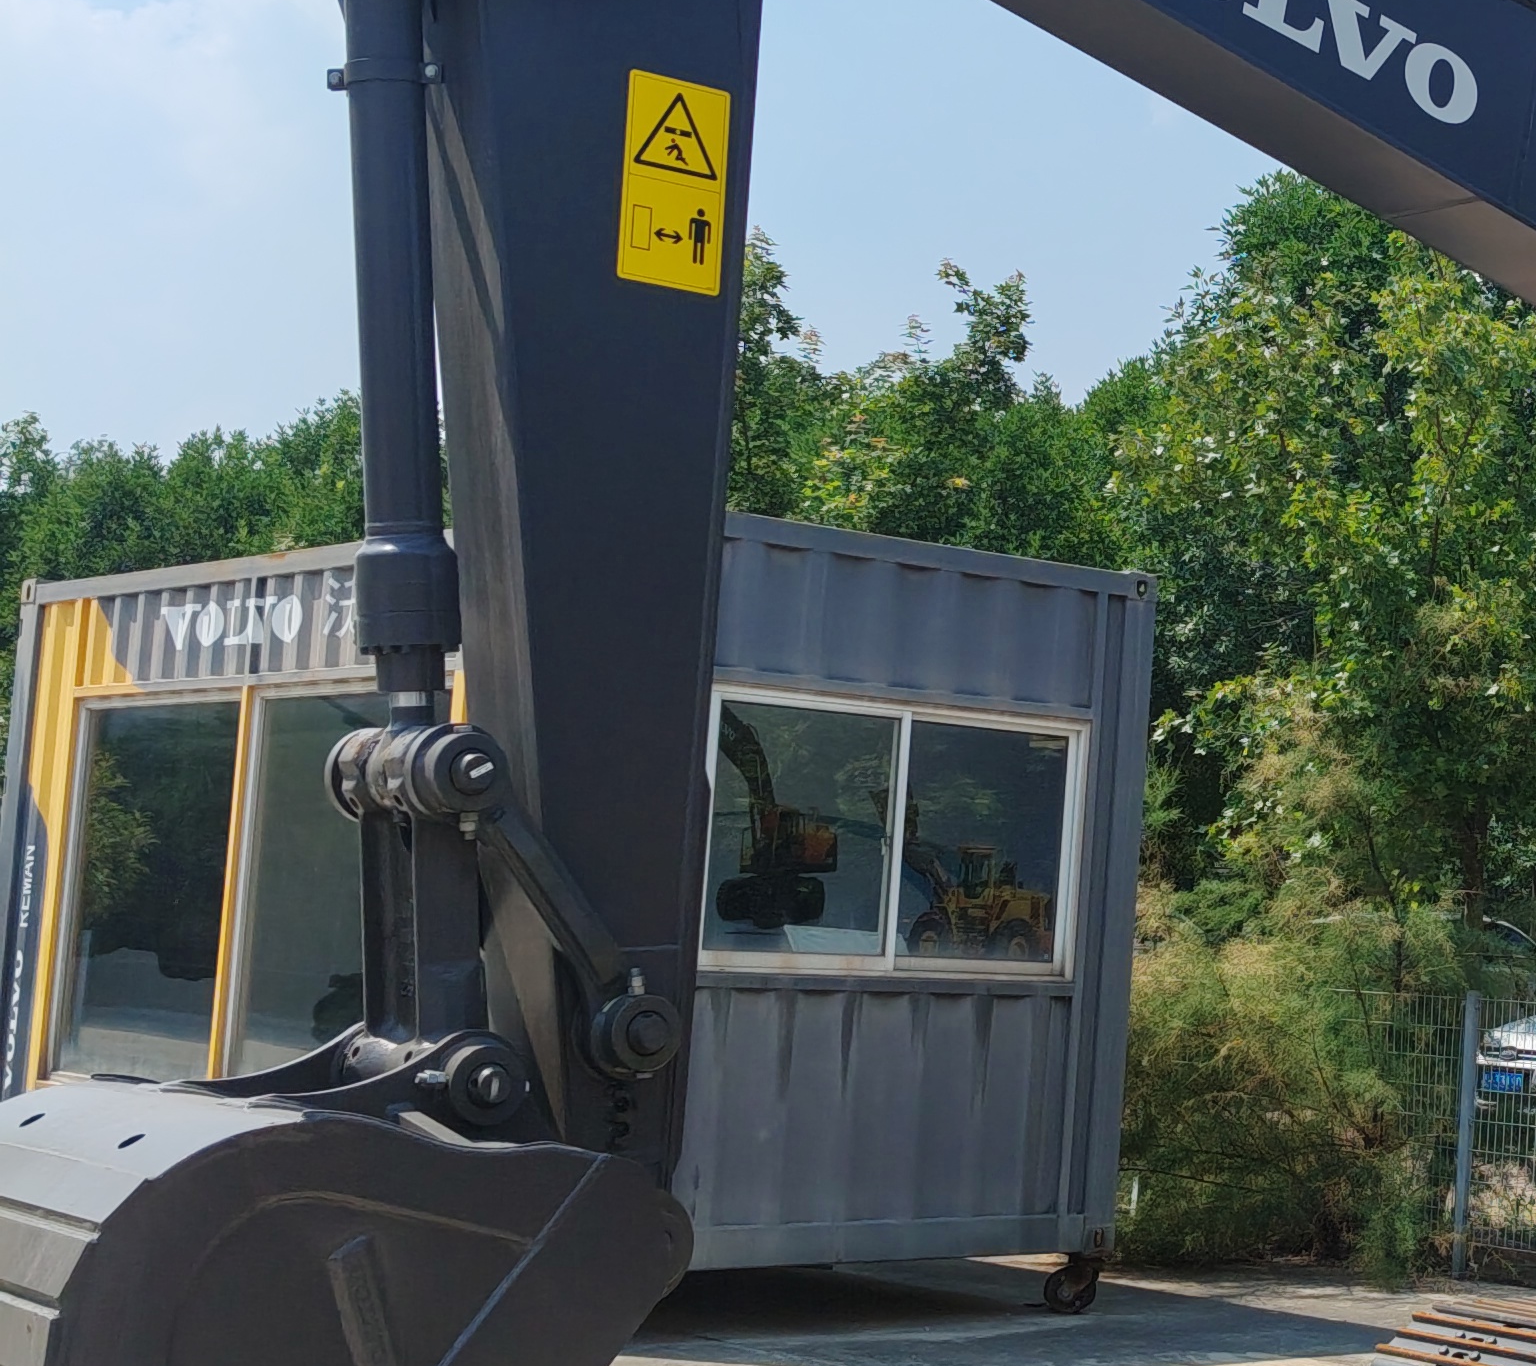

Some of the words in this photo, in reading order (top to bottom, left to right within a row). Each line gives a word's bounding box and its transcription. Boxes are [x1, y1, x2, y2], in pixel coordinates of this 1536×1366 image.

[160, 594, 304, 651] VOLVO
[4, 949, 24, 1090] VOLVO
[19, 845, 36, 928] REMAN
